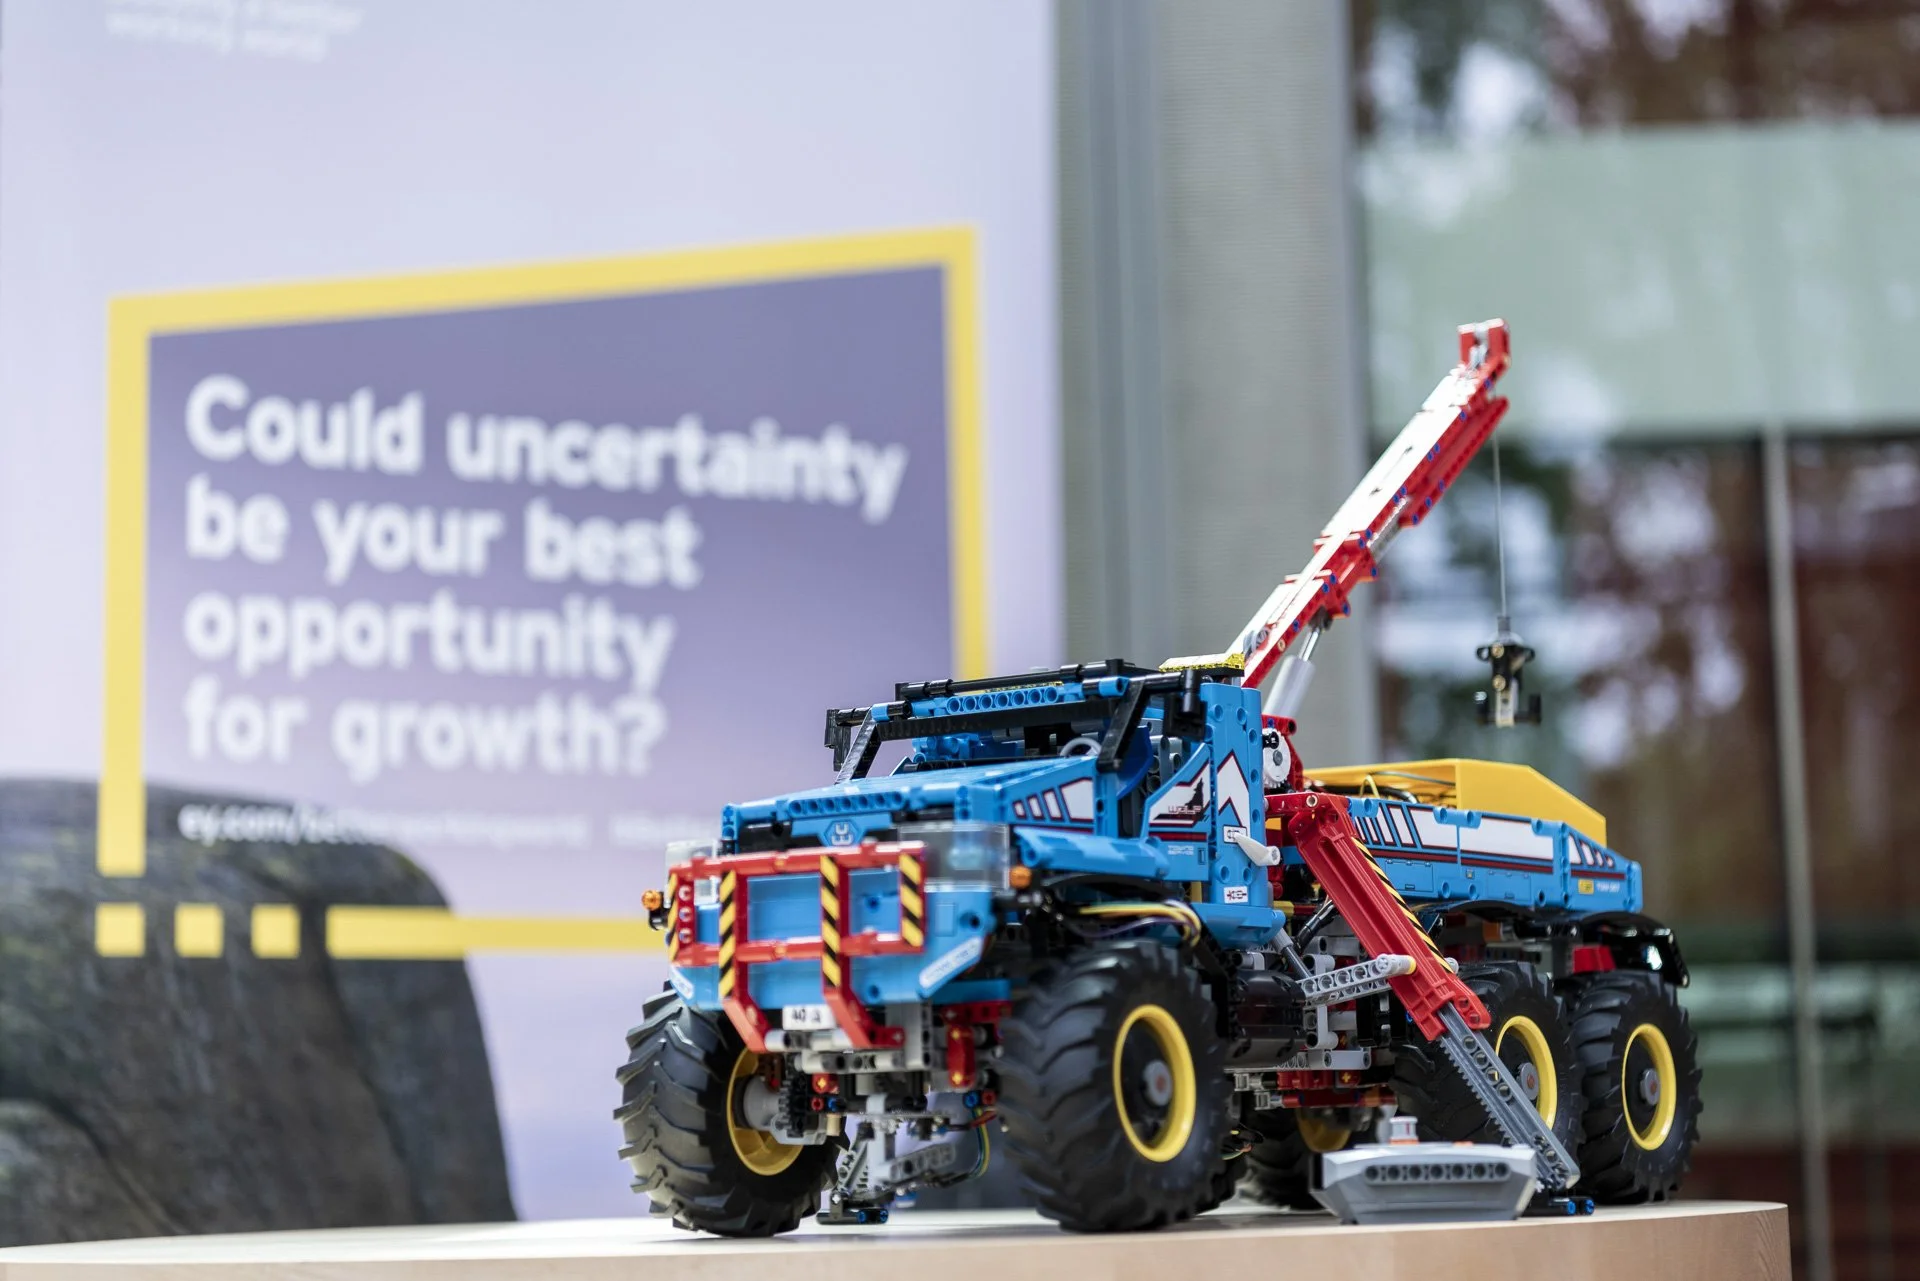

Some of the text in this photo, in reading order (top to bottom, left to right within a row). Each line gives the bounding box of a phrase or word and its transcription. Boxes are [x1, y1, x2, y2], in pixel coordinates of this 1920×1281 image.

[185, 374, 908, 524] Could uncertainty
[186, 473, 702, 589] be your best
[185, 588, 674, 695] opportunity
[186, 675, 667, 783] for growth?
